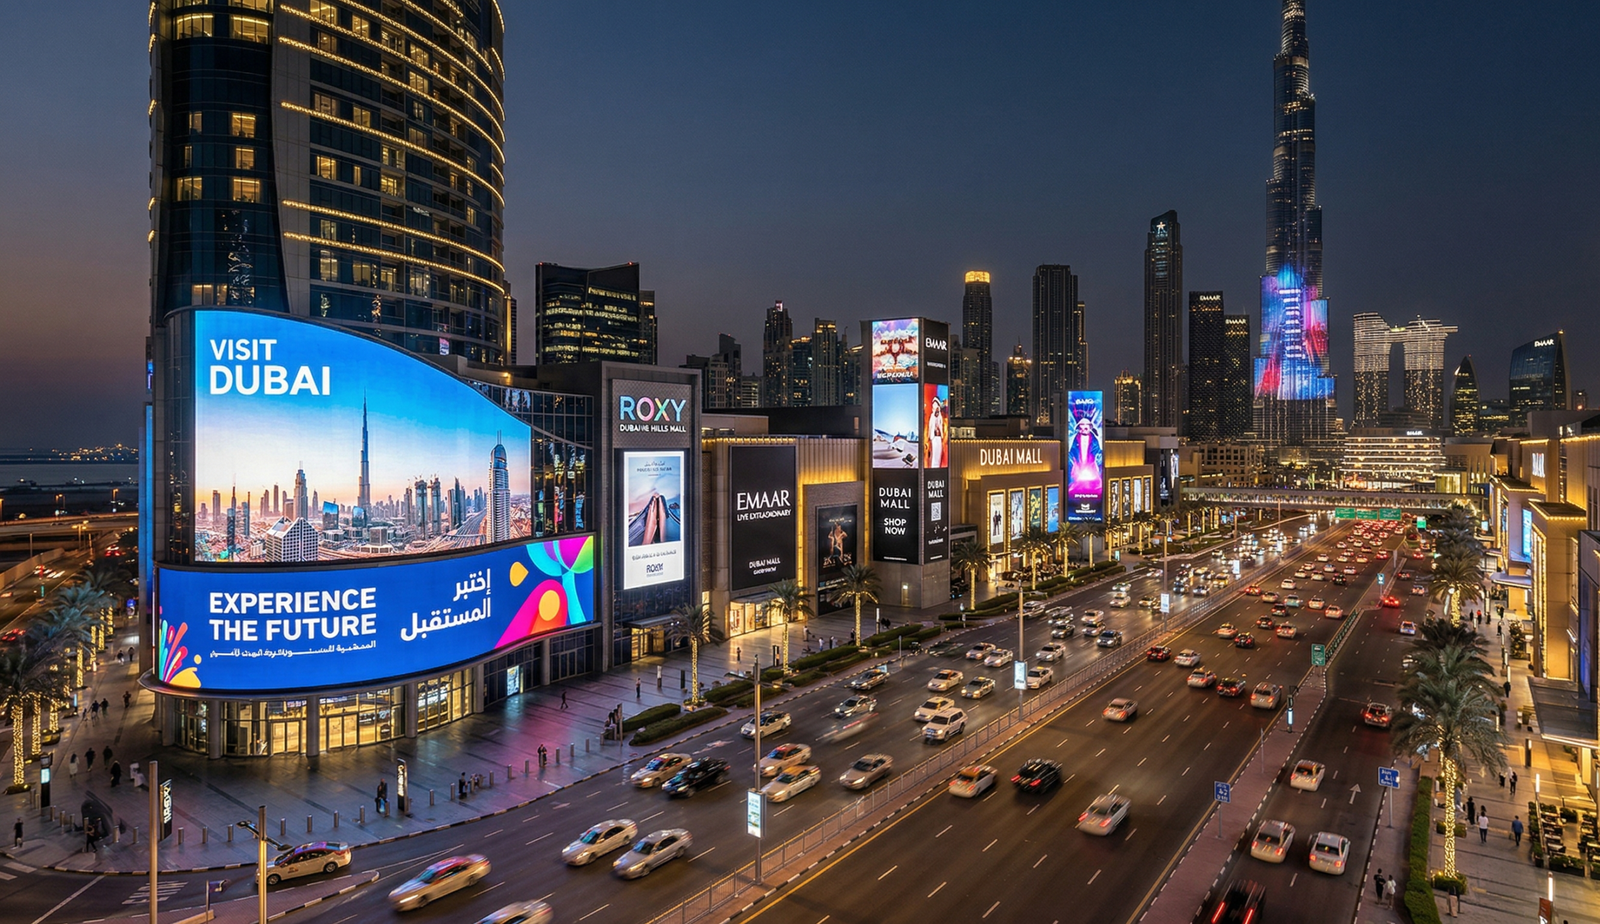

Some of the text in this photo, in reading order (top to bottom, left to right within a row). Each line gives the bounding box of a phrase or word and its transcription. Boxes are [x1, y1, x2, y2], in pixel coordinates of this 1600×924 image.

[209, 338, 277, 361] VISIT
[210, 364, 331, 396] DUBAI
[619, 395, 687, 422] ROXY
[980, 448, 1043, 466] DUBAI MALL
[878, 487, 912, 498] DUBAI
[927, 480, 945, 490] DUBAI
[928, 489, 944, 499] MALL
[736, 489, 791, 511] EMAAR
[880, 498, 911, 509] MALL
[883, 517, 907, 527] SHOP
[884, 526, 906, 536] NOW
[453, 568, 491, 602] إختبر
[209, 587, 377, 614] EXPERIENCE
[209, 613, 377, 642] THE FUTURE
[400, 597, 491, 642] المستقبل
